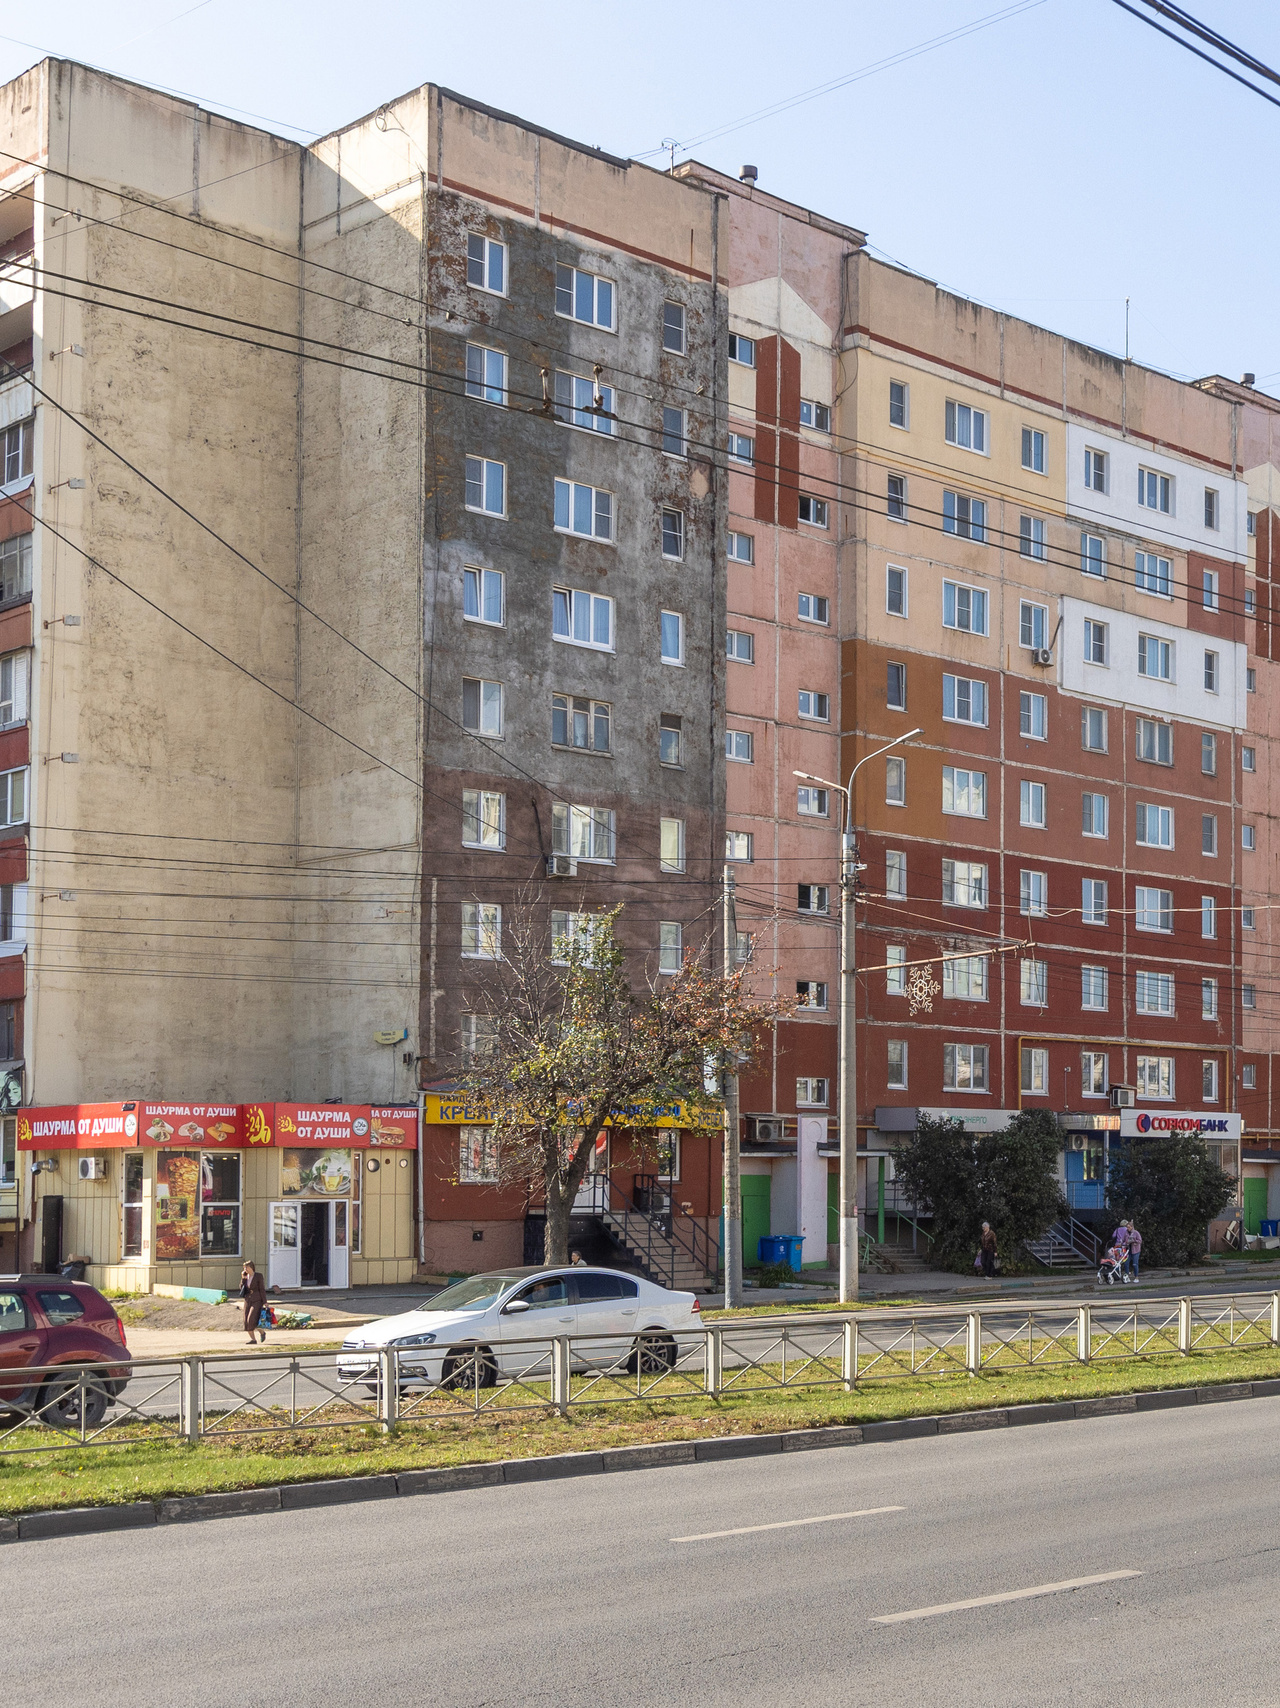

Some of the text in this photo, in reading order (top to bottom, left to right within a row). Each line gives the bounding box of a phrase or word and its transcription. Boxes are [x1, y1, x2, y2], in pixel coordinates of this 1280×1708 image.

[145, 1106, 237, 1117] ШАУРМА ОТ ДУШИ
[297, 1110, 351, 1122] ШАУРМА
[392, 1110, 417, 1118] ДУШИ
[250, 1116, 260, 1132] 24
[963, 1116, 988, 1124] ЭНЕРГО
[1151, 1117, 1229, 1132] СОВКОМБАНК
[33, 1117, 124, 1136] ШАУРМА ОТ ДУШИ
[297, 1127, 351, 1140] ОТ ДУШИ
